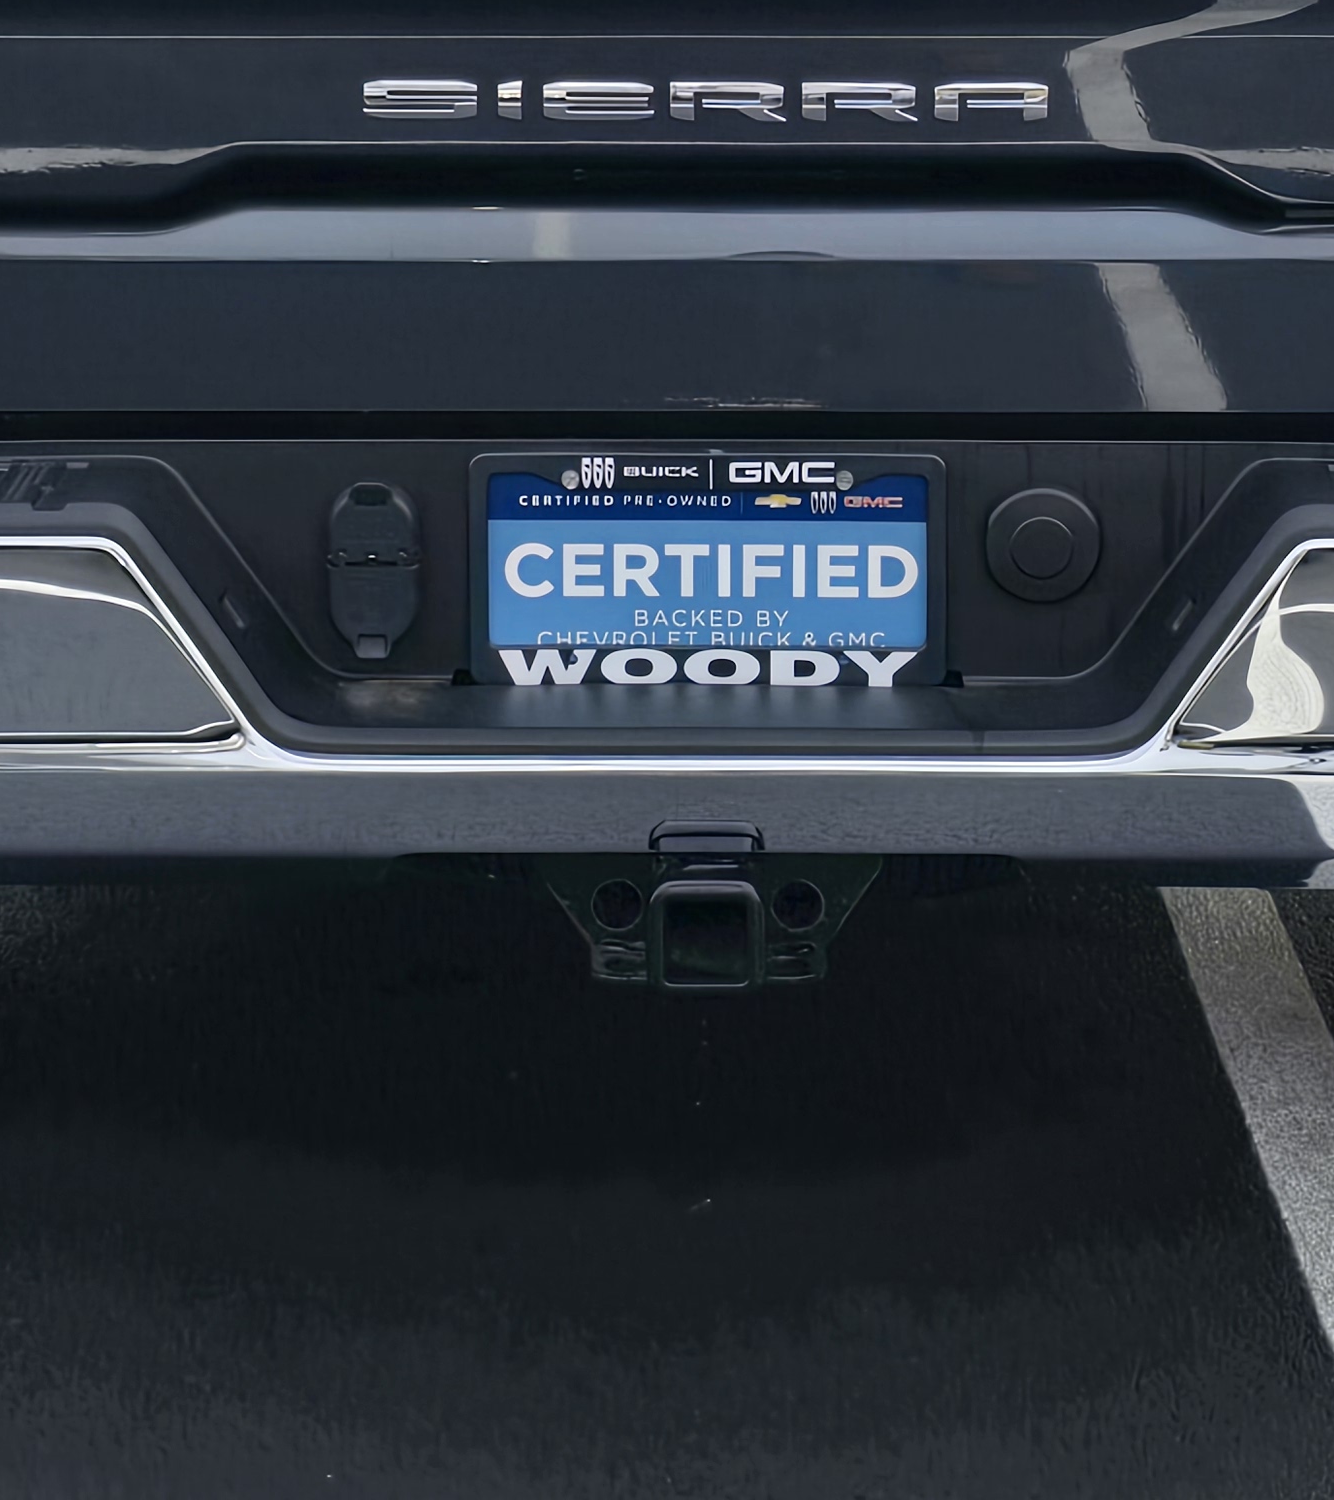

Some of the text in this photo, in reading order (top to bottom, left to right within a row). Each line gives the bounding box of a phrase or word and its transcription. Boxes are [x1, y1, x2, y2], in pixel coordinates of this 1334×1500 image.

[362, 79, 1050, 123] SIERRA
[623, 461, 836, 484] BUICK GMC
[518, 495, 615, 507] CERTIFIED
[844, 496, 904, 508] GMC
[504, 542, 919, 599] CERTIFIED
[634, 609, 789, 627] BACKED BY
[536, 631, 699, 646] CHEVROLET
[710, 631, 792, 646] BUICK
[828, 632, 886, 647] GMC
[497, 648, 918, 686] WOODY
